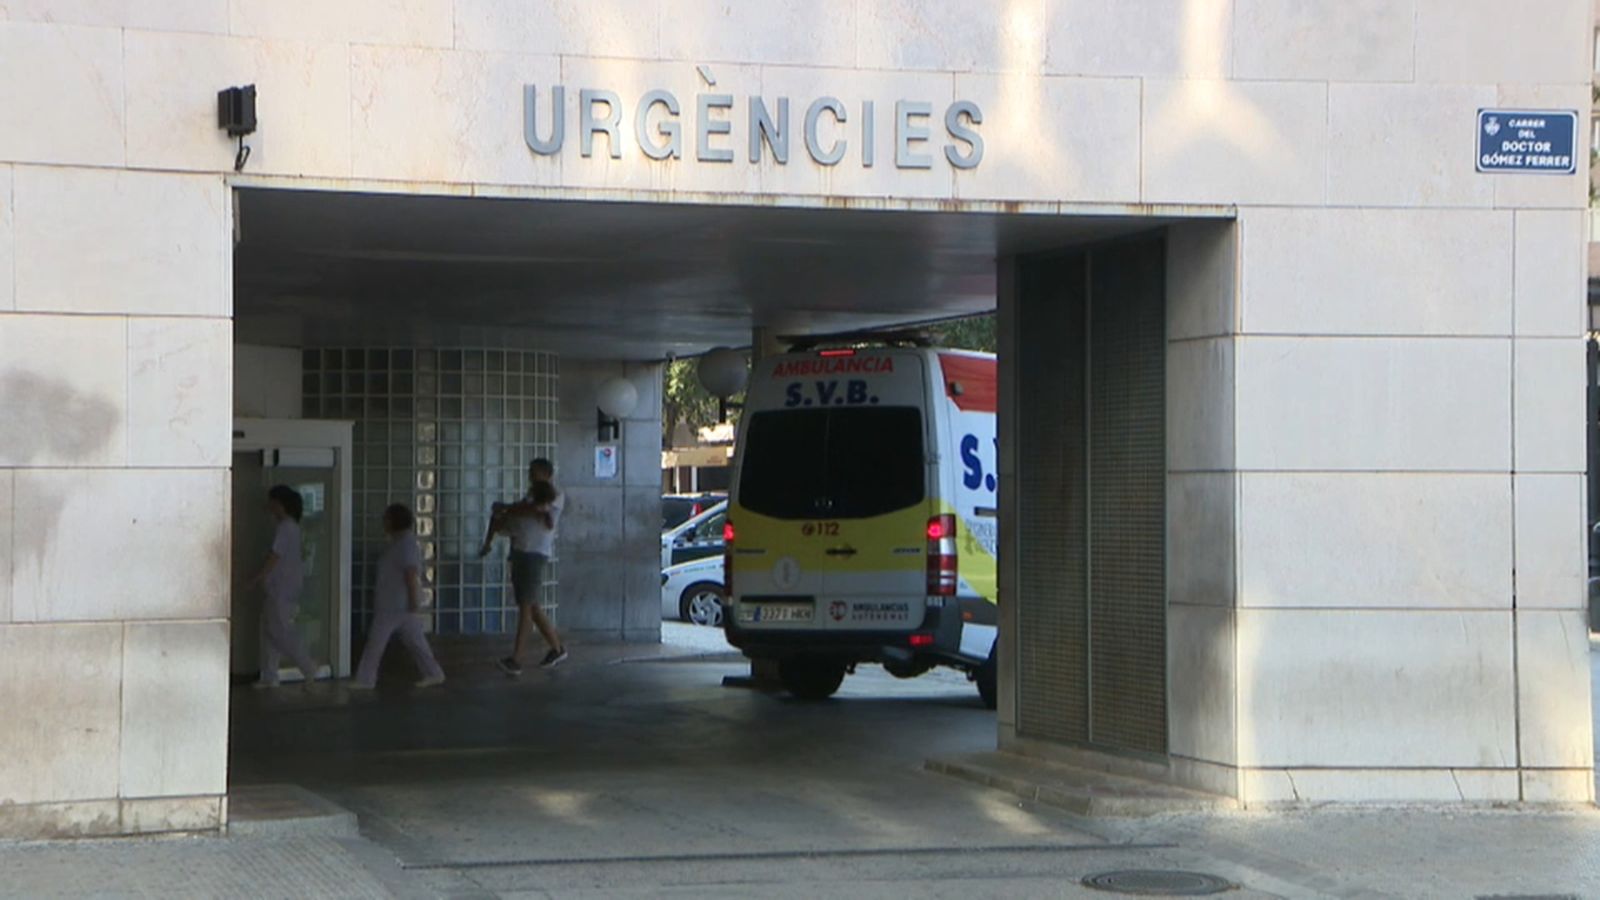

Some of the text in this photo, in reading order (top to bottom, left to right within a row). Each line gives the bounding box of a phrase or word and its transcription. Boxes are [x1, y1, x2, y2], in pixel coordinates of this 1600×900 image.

[523, 65, 984, 170] URGÈNCIES
[1508, 119, 1546, 128] CARRER
[1518, 129, 1536, 139] DEL
[1502, 141, 1552, 153] DOCTOR
[1481, 152, 1570, 167] GÓMEZ FERRER
[771, 356, 895, 378] AMBULANCIA
[784, 379, 880, 408] S.V.B.
[816, 521, 840, 537] 112
